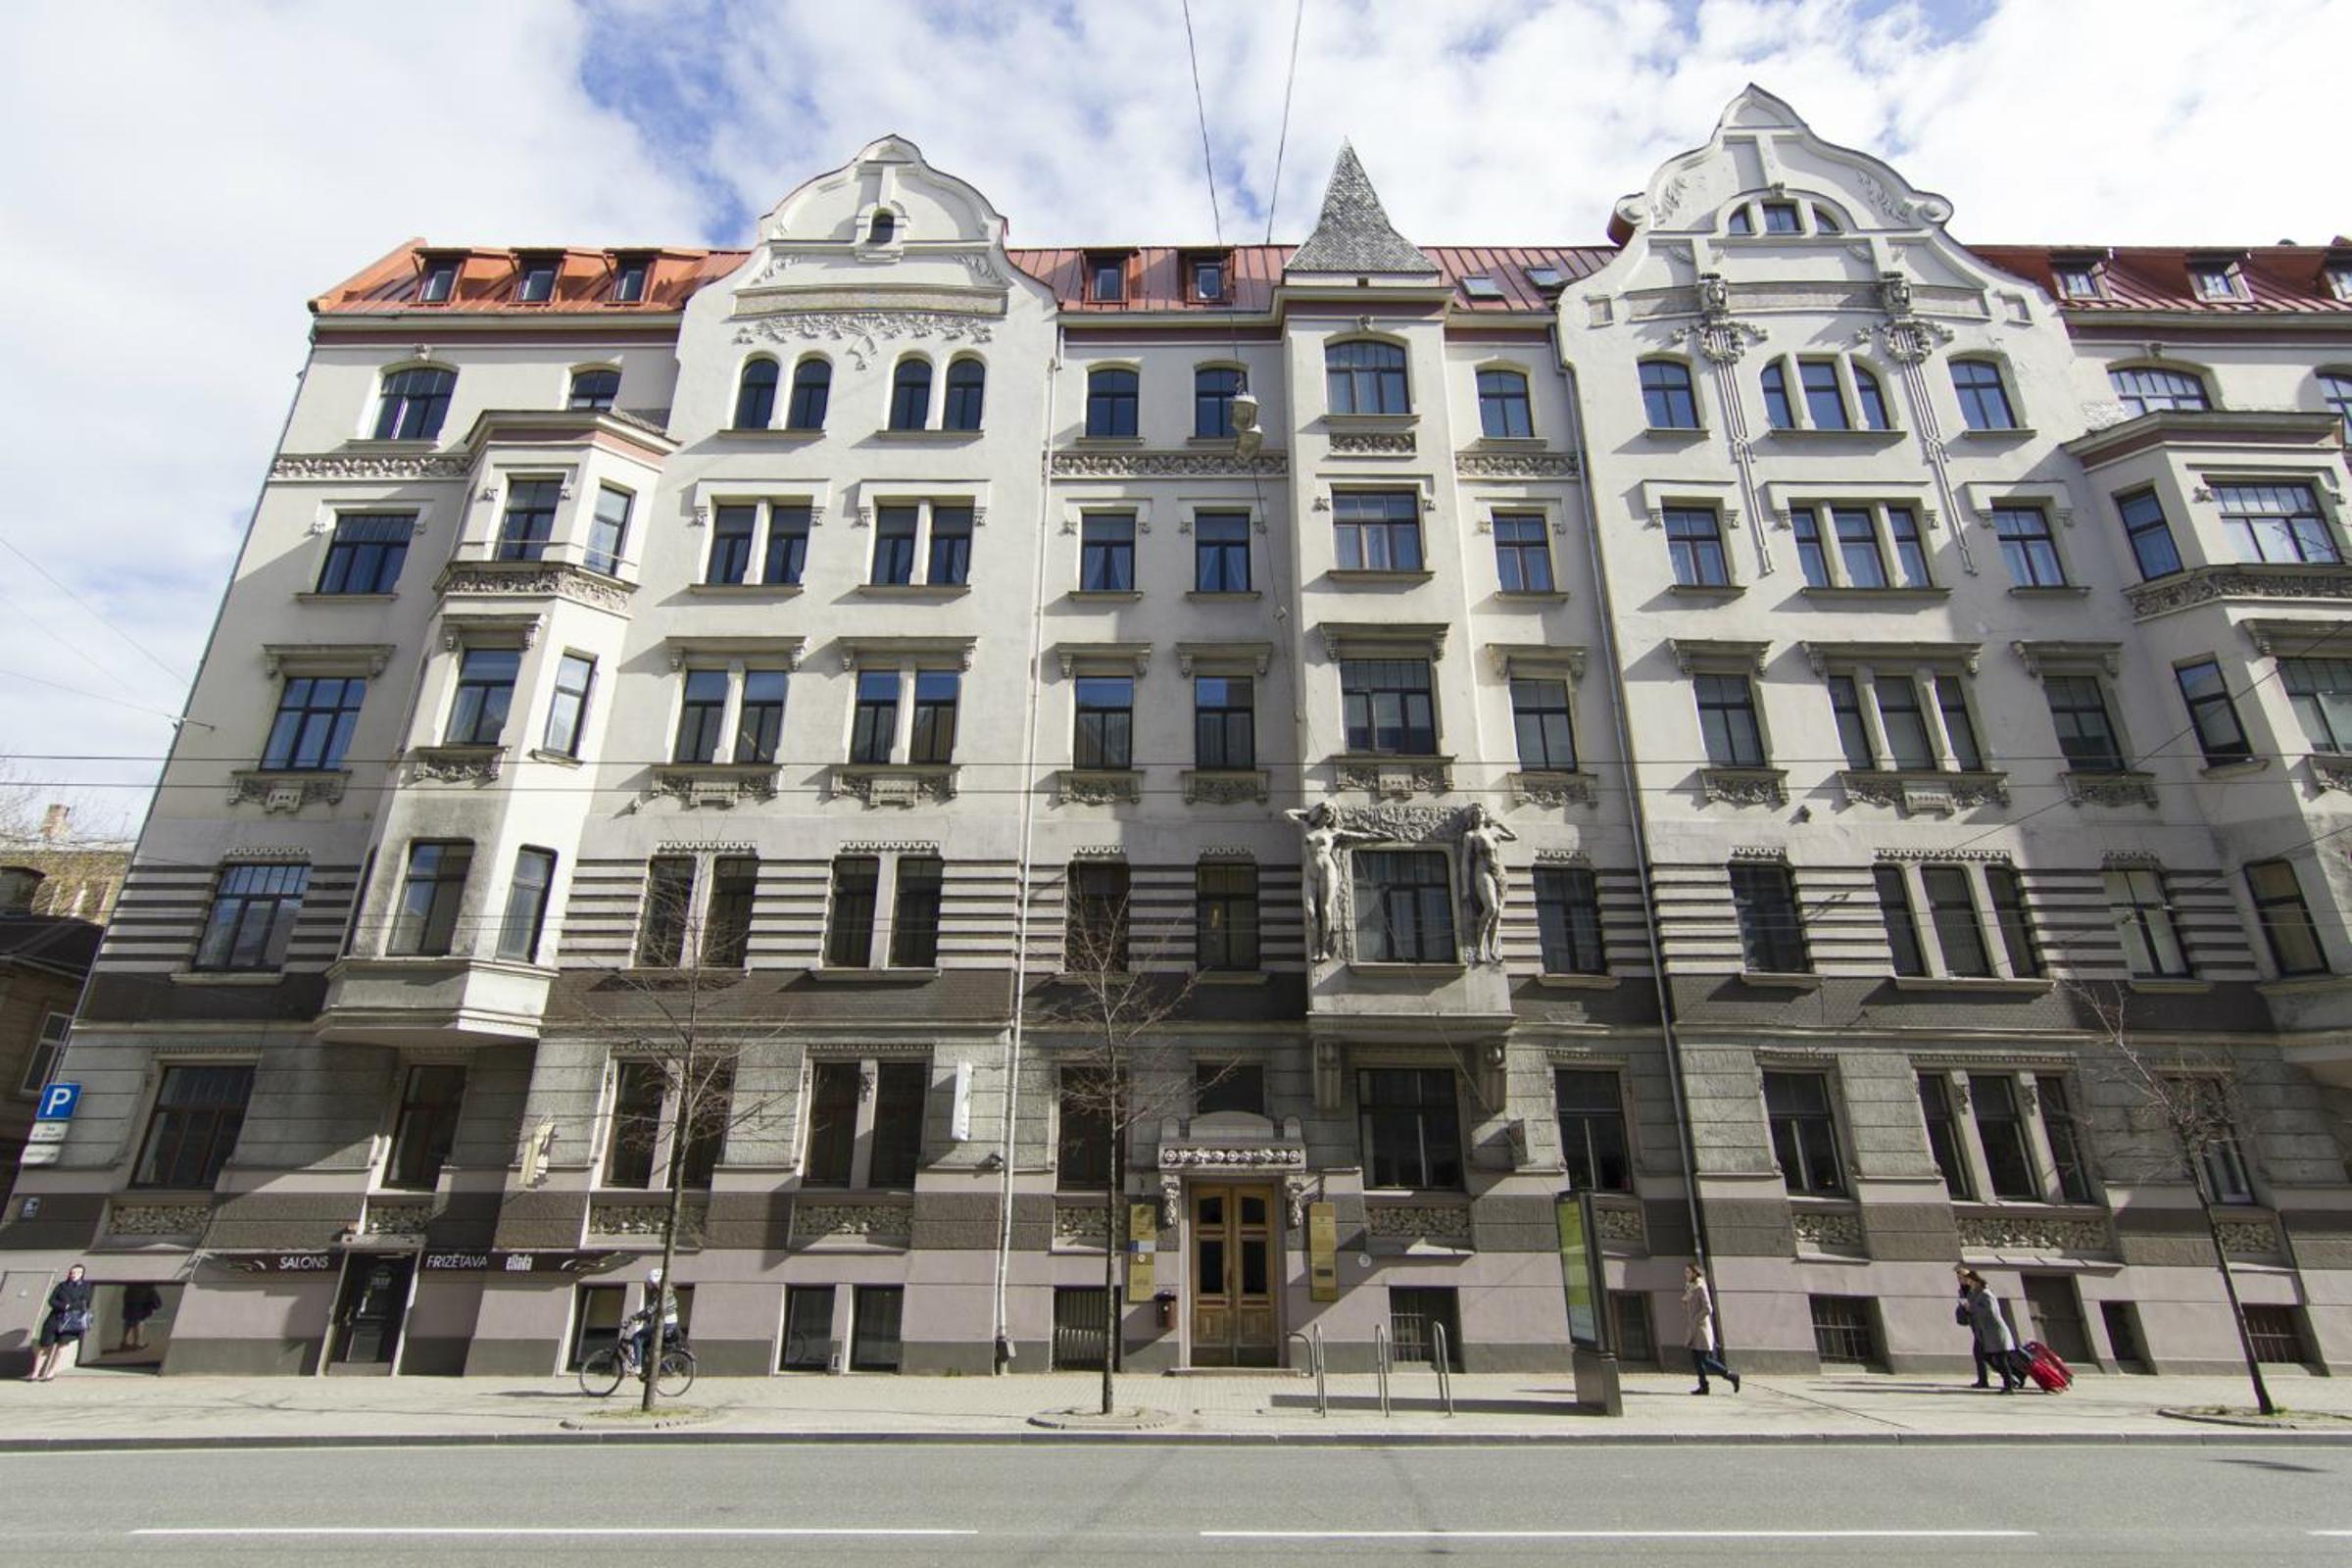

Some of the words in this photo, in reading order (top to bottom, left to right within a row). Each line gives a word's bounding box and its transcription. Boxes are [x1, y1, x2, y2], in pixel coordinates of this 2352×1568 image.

[46, 1088, 72, 1116] P
[278, 1255, 329, 1270] SALONS
[425, 1252, 489, 1269] FRIZĒTAVA
